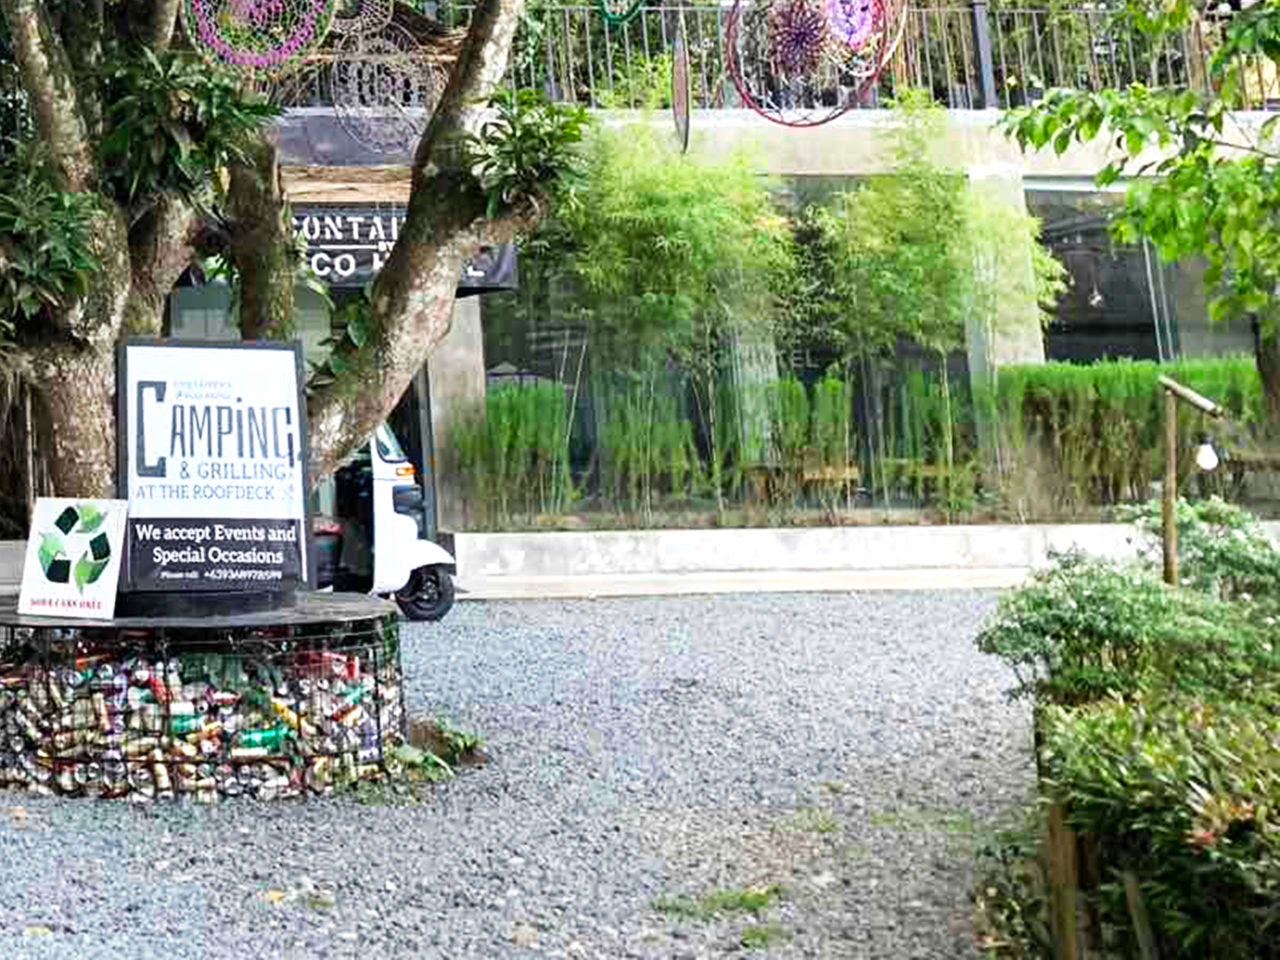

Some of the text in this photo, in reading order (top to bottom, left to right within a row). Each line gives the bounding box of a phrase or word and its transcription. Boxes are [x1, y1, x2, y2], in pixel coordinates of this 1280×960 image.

[311, 253, 356, 277] CO
[179, 460, 287, 480] & GRILLING
[135, 484, 275, 501] AT THE ROOFDECK
[135, 524, 297, 543] We accept Events and
[152, 546, 284, 565] Special Occasions
